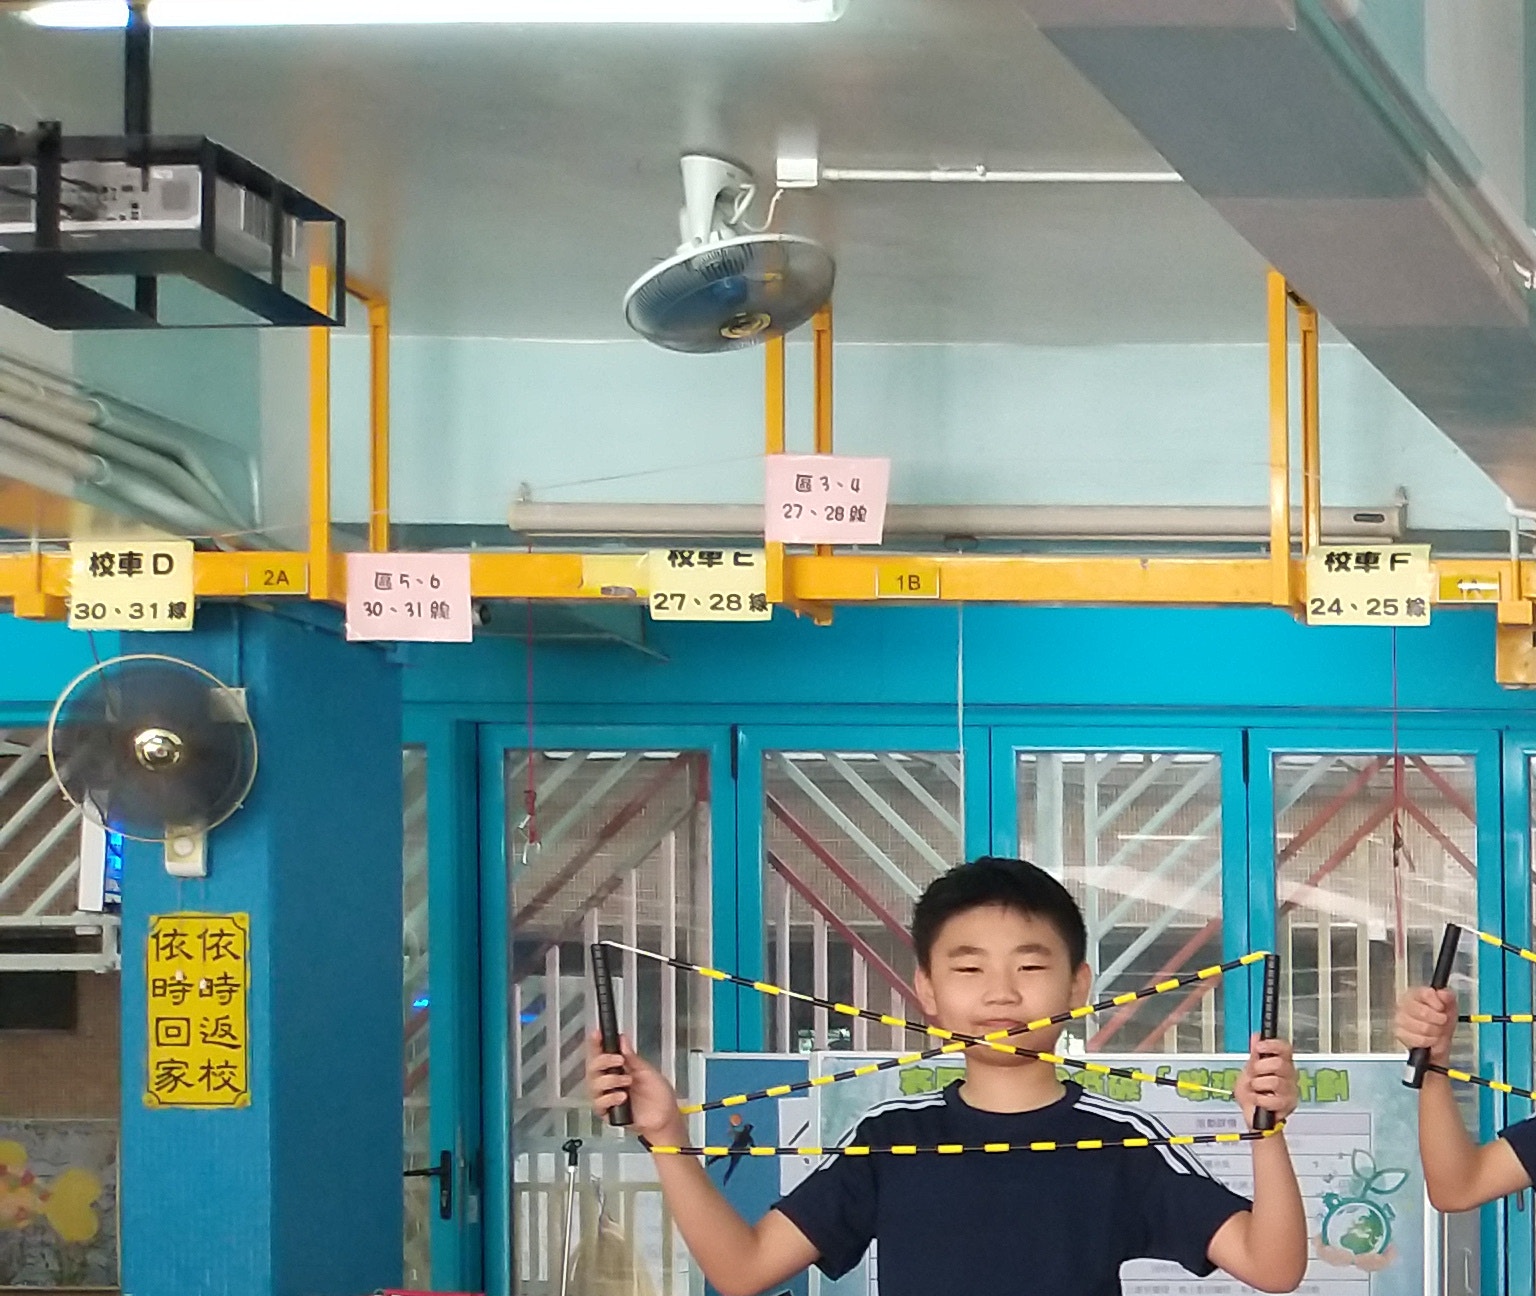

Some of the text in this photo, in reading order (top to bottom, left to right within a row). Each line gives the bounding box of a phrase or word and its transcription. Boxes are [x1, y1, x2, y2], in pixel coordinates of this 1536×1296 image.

[152, 554, 174, 575] D
[1389, 552, 1411, 572] F
[263, 571, 290, 586] 2A
[896, 574, 921, 591] 1B
[151, 927, 195, 1094] 依時回家
[197, 927, 242, 1093] 依時返校
